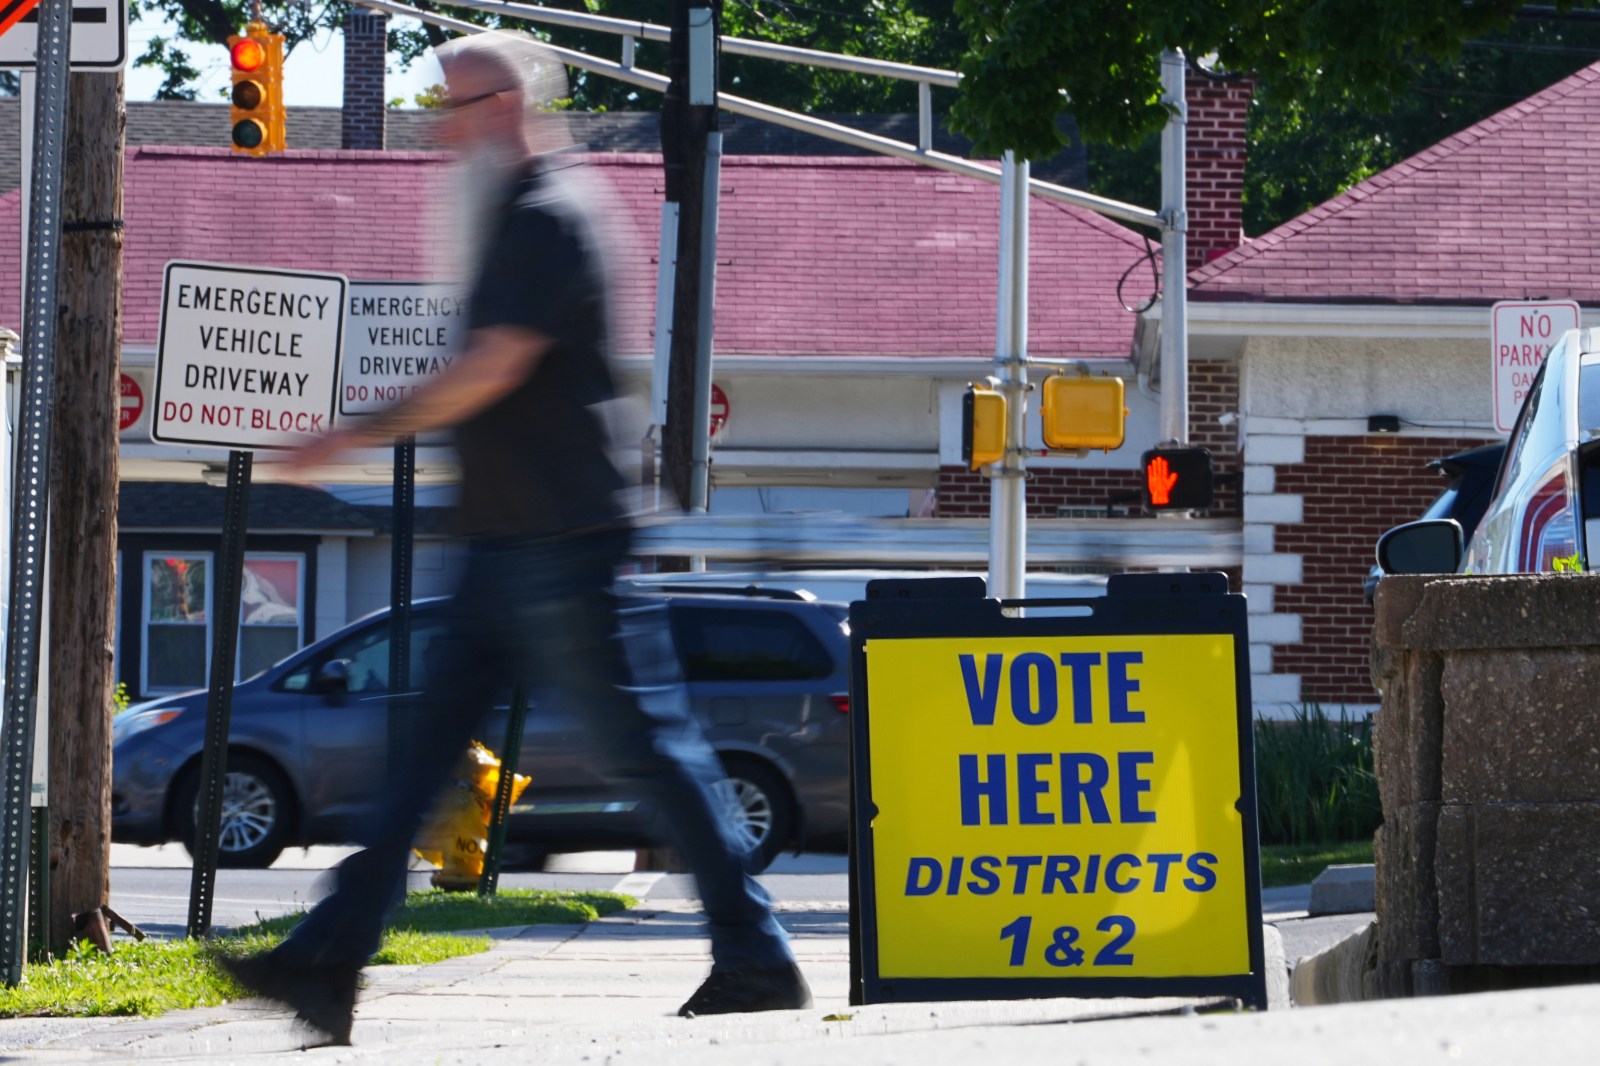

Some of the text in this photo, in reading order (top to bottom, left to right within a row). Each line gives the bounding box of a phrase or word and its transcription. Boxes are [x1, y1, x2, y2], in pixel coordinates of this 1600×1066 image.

[178, 284, 329, 320] EMERGENCY
[350, 297, 463, 317] EMERGENCY
[200, 325, 303, 358] VEHICLE
[368, 327, 447, 346] VEHICLE
[1520, 314, 1551, 338] NO
[185, 364, 309, 397] DRIVEWAY
[346, 385, 368, 401] DO
[374, 385, 406, 401] NOT
[163, 401, 324, 433] DO NOT BLOCK
[958, 651, 1146, 726] VOTE
[958, 751, 1157, 826] HERE
[904, 852, 1219, 897] DISTRICTS
